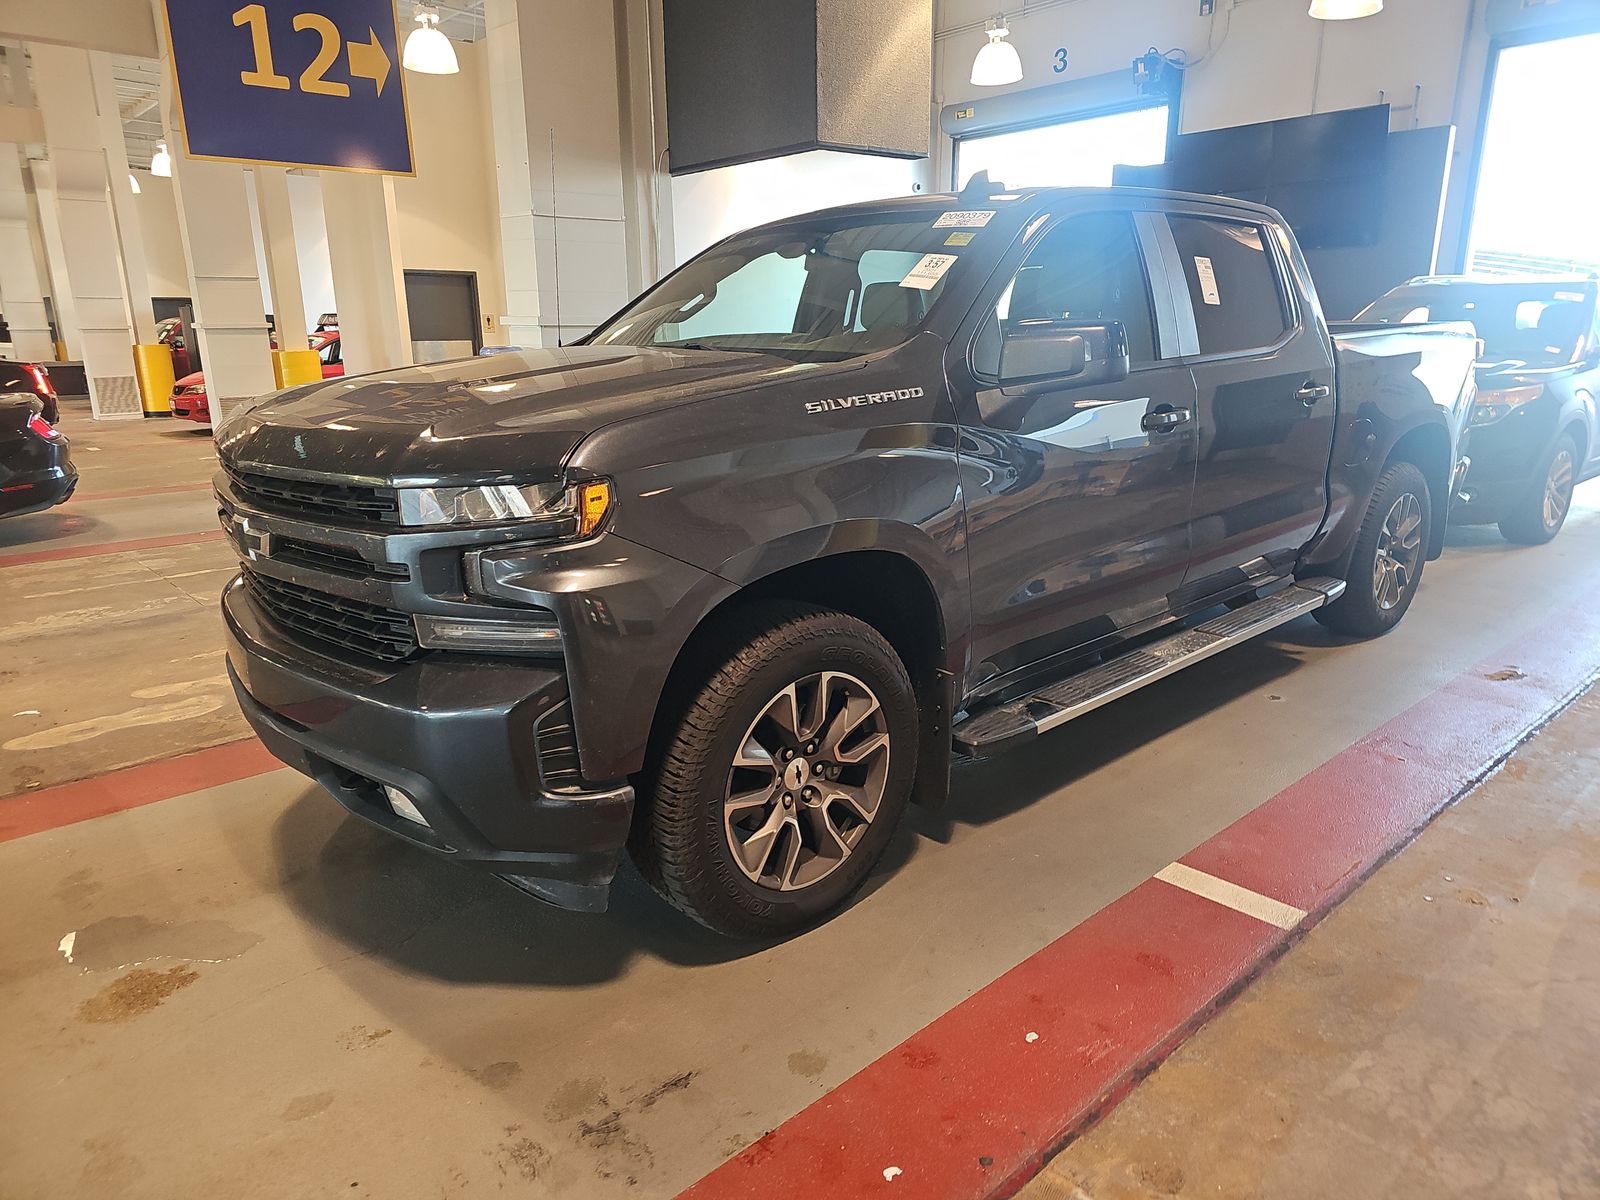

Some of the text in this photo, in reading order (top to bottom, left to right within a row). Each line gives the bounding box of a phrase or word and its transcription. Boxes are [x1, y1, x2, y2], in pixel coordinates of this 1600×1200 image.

[232, 4, 350, 98] 12
[1053, 48, 1069, 74] 3
[805, 386, 924, 415] SILVERADO
